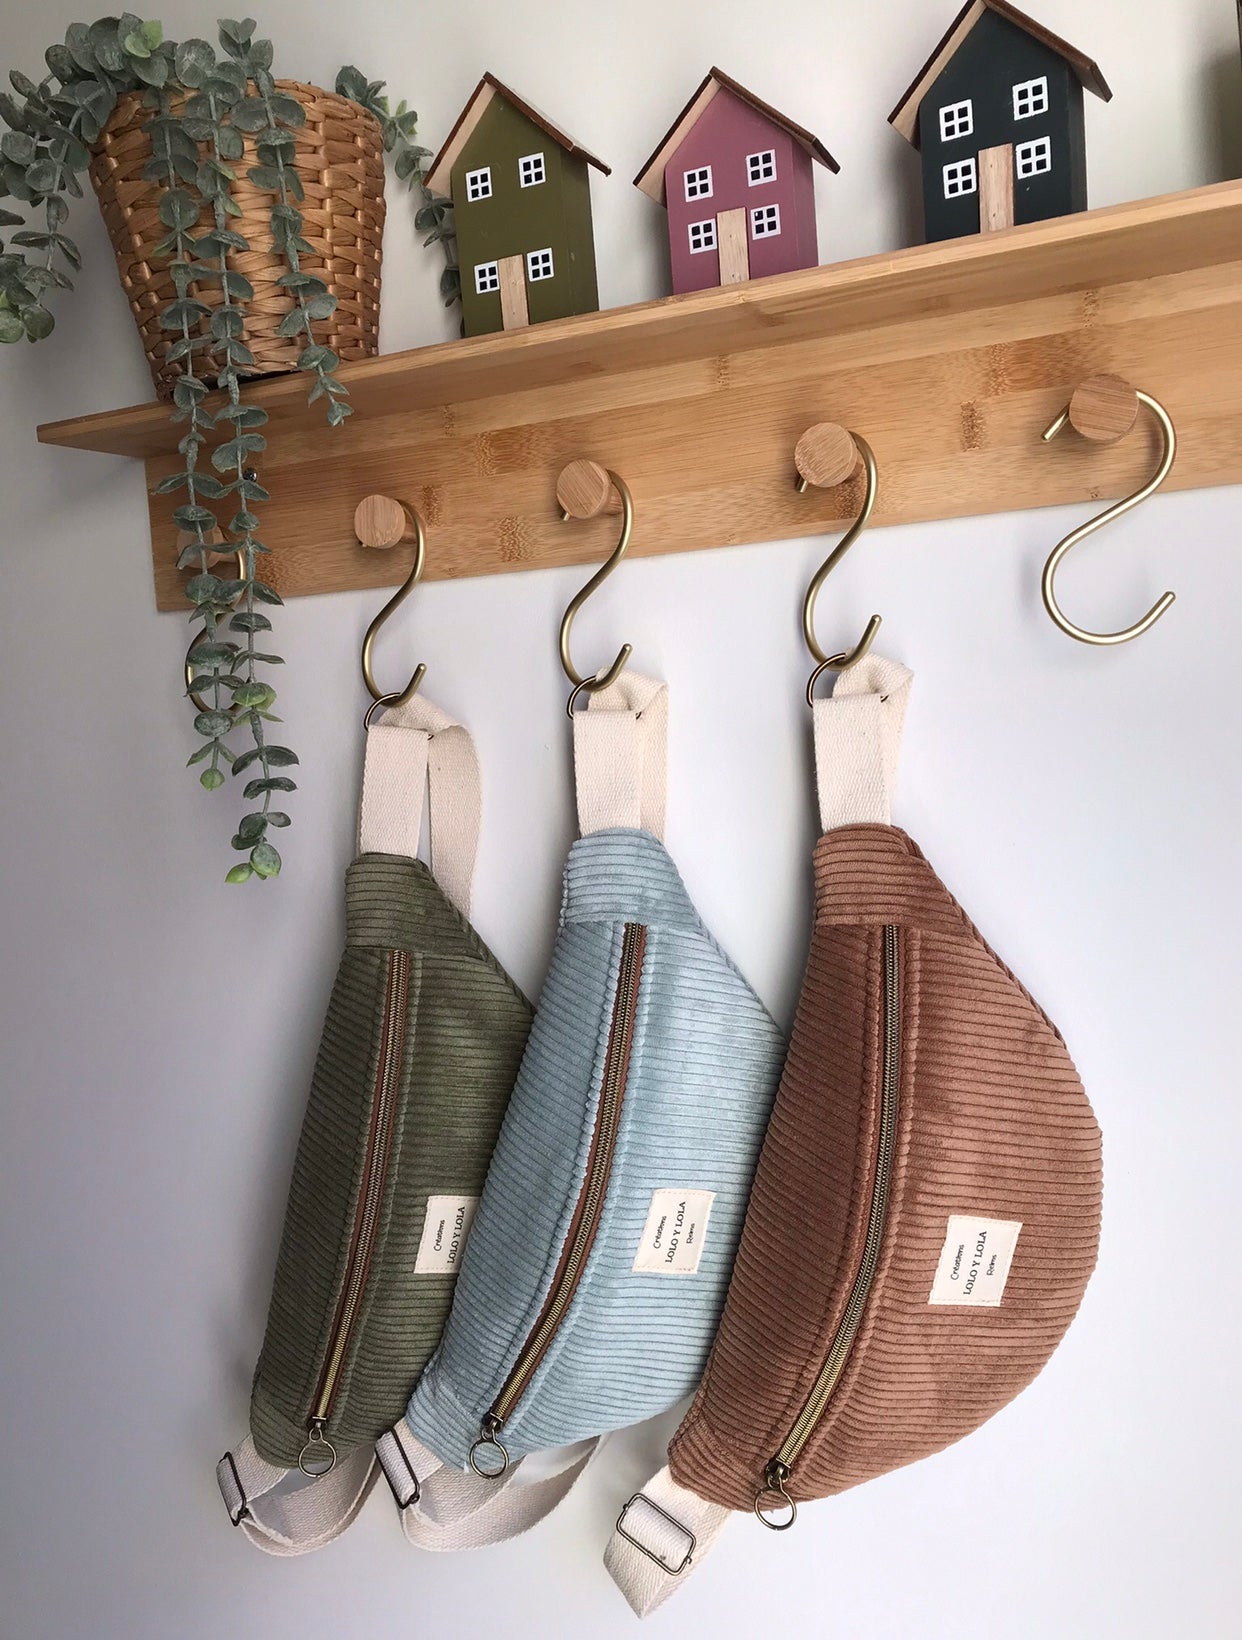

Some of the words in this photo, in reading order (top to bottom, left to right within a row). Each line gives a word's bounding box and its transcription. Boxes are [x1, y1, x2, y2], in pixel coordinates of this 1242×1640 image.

[447, 1240, 459, 1264] LOLO
[455, 1206, 465, 1230] LOLA
[665, 1238, 679, 1263] LOLO
[675, 1201, 686, 1227] LOLA
[963, 1269, 978, 1295] LOLO
[974, 1231, 987, 1258] LOLA
